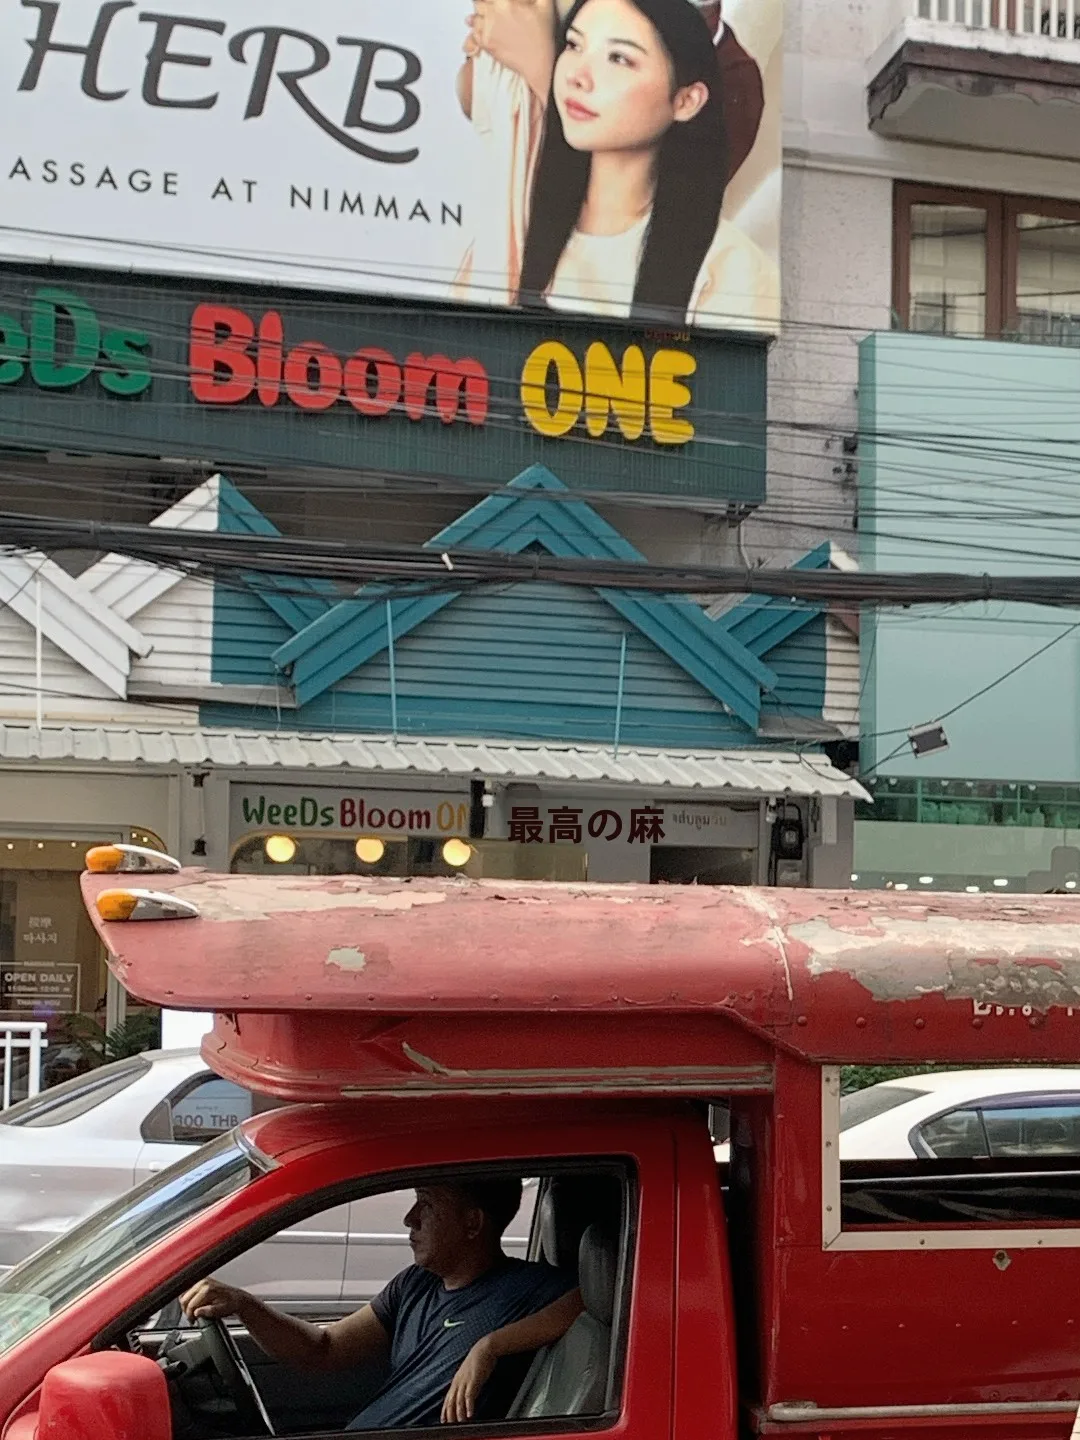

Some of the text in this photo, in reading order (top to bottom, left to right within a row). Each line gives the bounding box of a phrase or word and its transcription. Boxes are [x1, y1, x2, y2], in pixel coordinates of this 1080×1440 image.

[17, 0, 422, 164] HERB
[9, 157, 463, 226] ASSAGE AT NIMMAN
[190, 304, 488, 425] Bloom
[521, 341, 697, 444] ONE
[242, 796, 335, 827] WeeDs
[340, 798, 431, 830] Bloom
[507, 806, 665, 844] 最高の麻
[4, 973, 74, 983] OPEN DAILY
